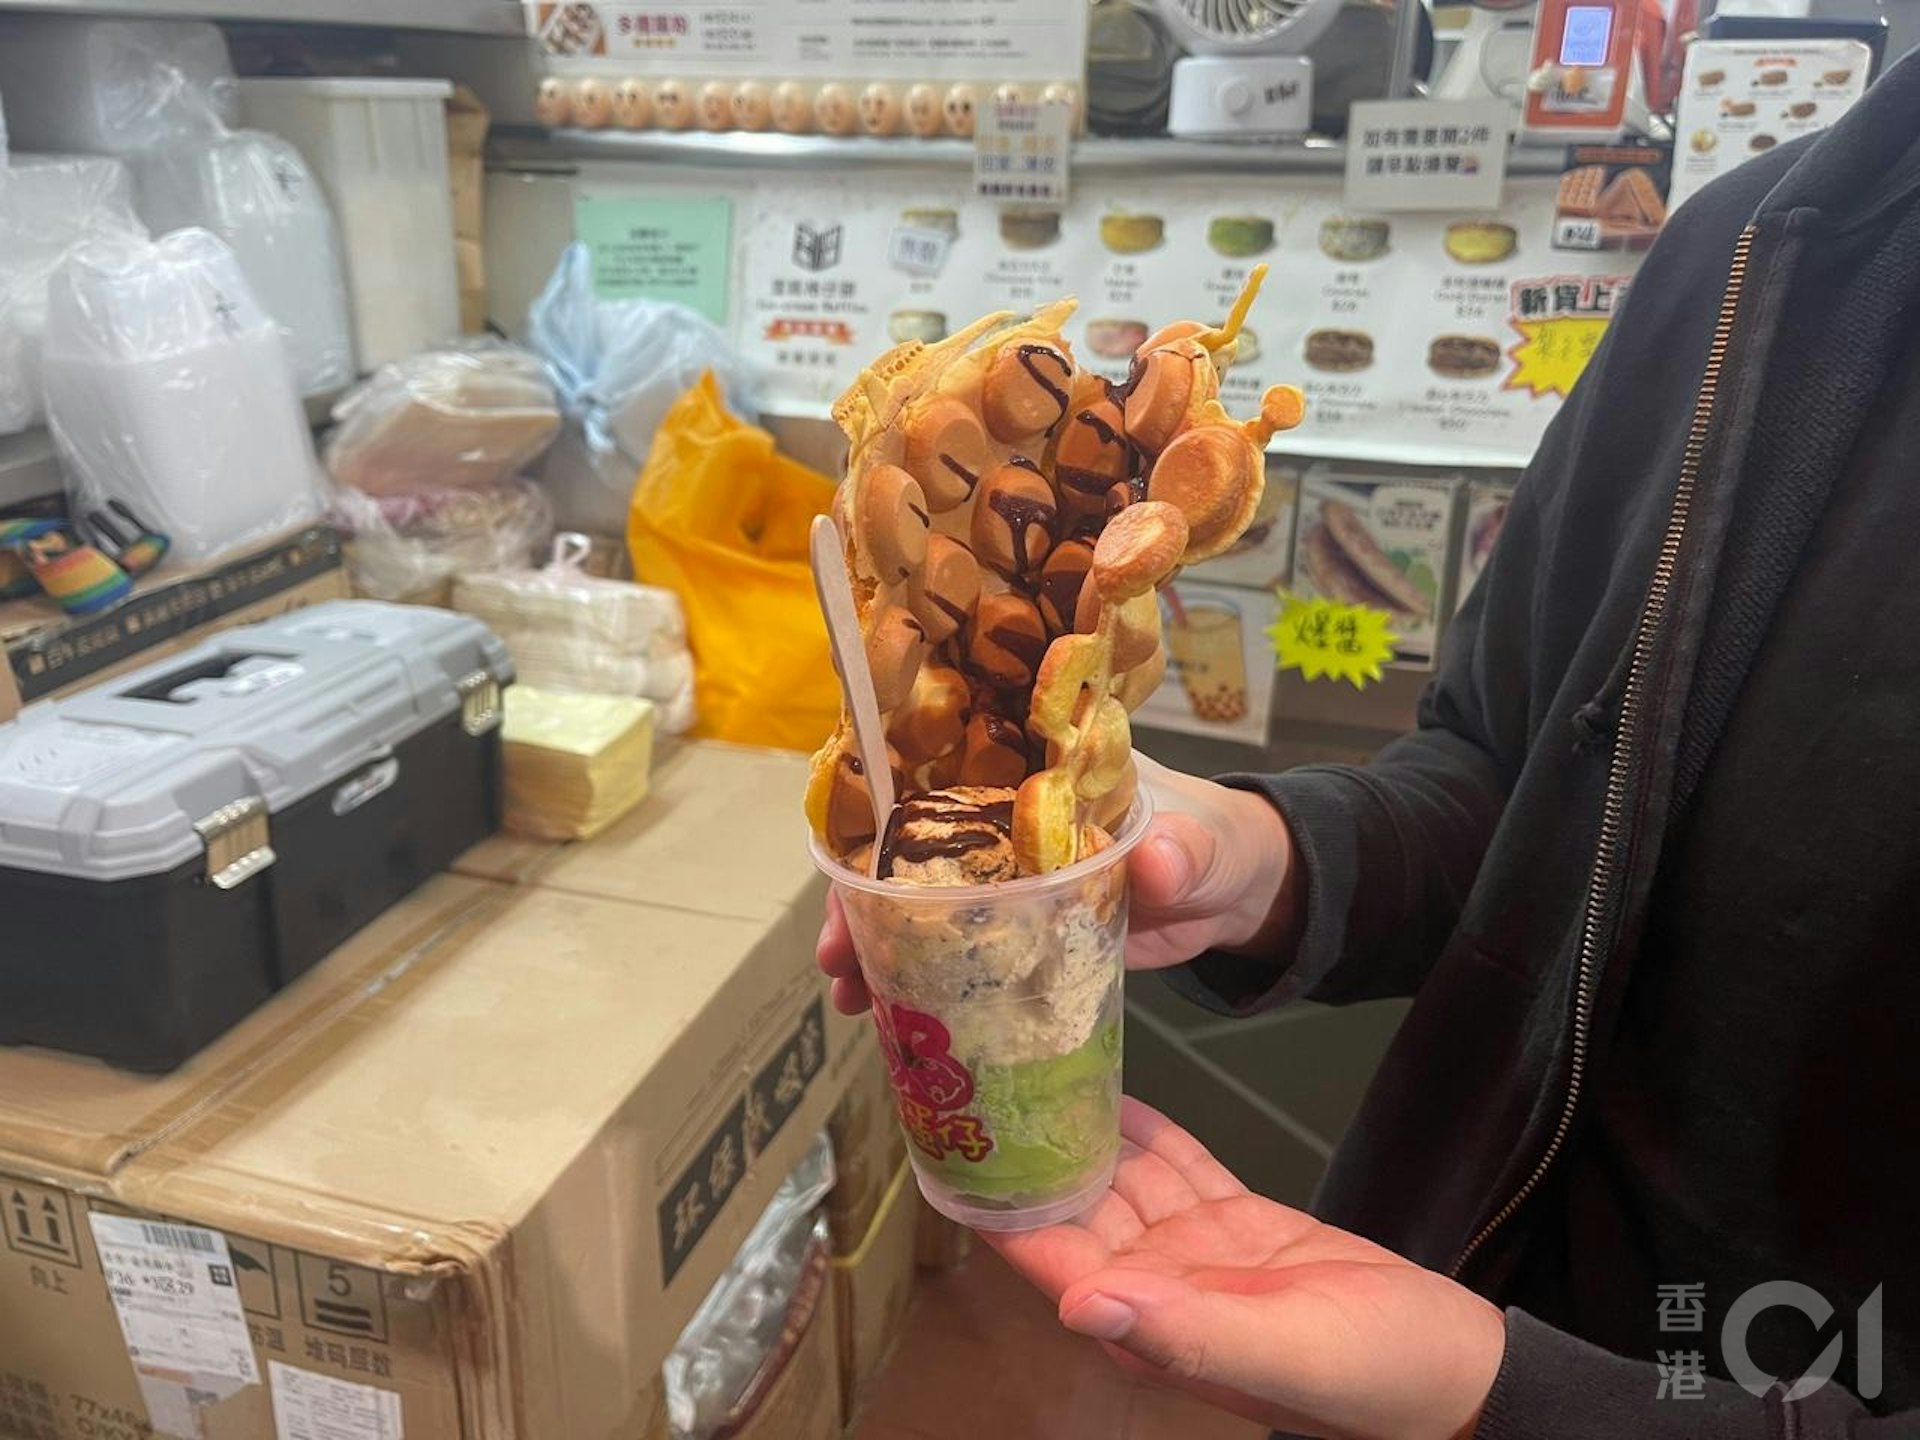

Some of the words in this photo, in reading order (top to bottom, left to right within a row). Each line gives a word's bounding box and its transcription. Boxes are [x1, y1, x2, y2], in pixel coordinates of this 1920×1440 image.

[1520, 282, 1630, 315] 新貨上
[327, 1262, 352, 1297] 5
